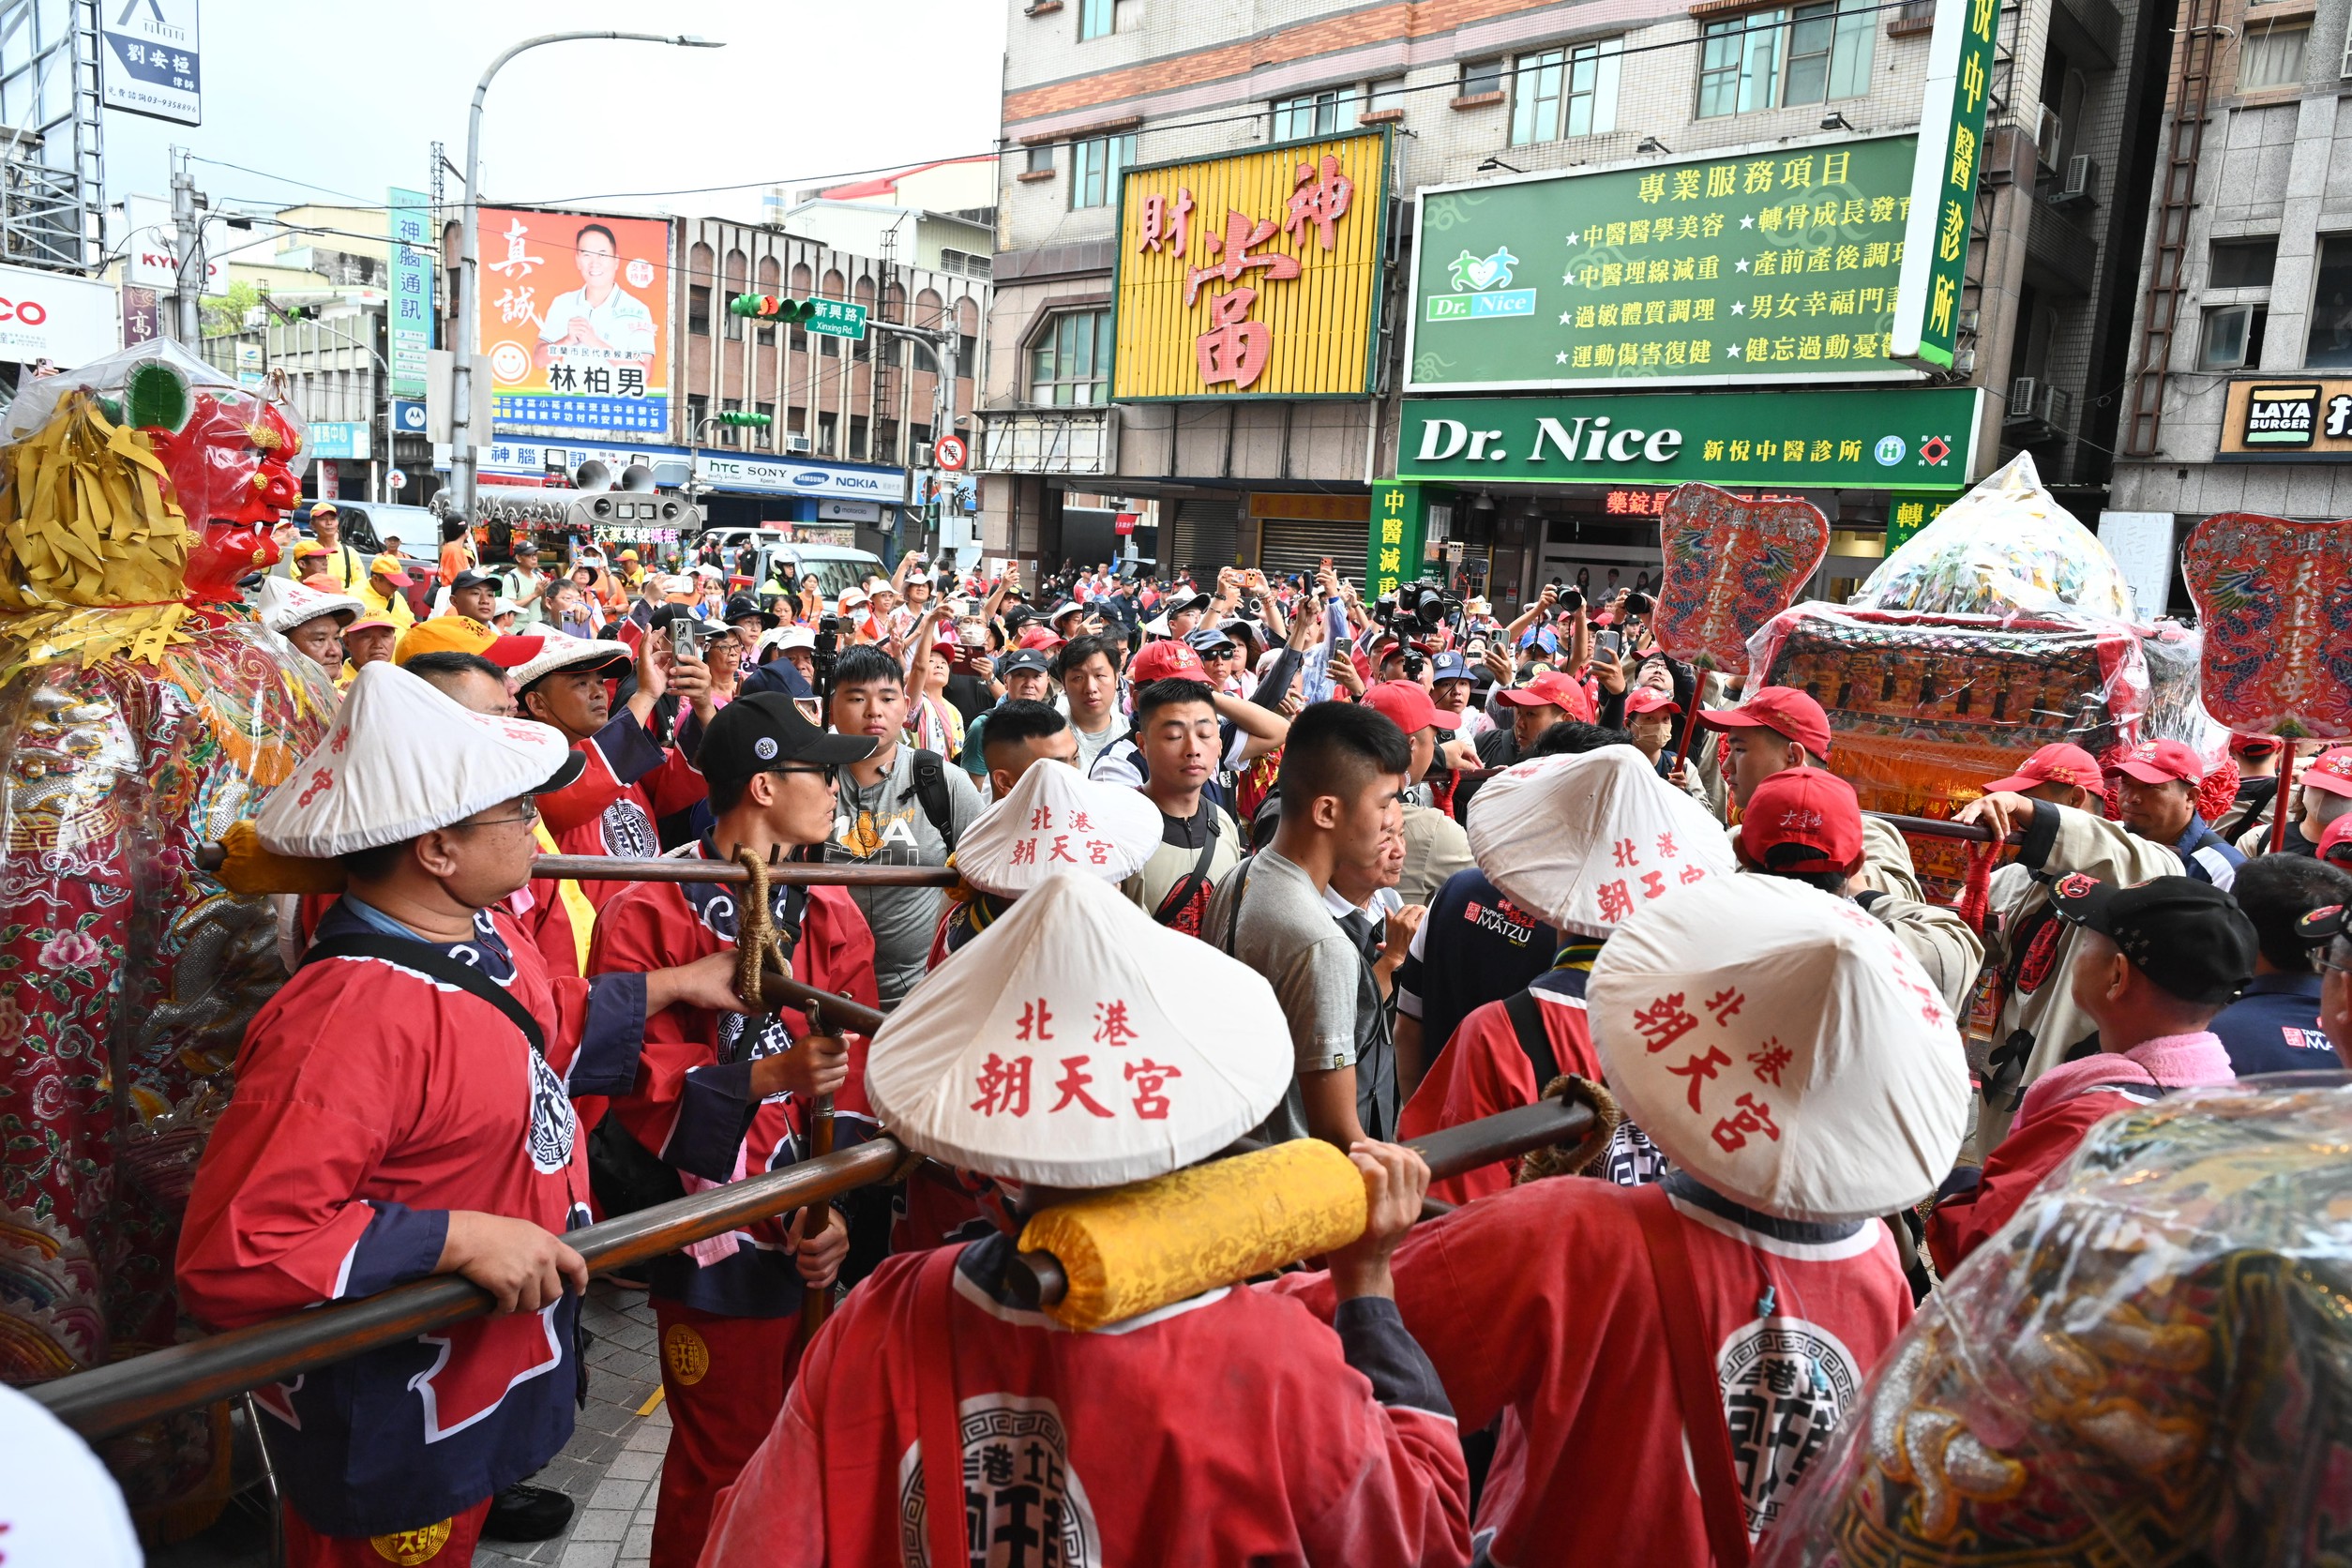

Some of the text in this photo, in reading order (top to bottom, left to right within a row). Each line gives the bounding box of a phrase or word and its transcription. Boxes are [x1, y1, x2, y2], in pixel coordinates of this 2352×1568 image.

[127, 43, 190, 74] 劉安桓
[173, 77, 194, 90] 律師
[1637, 151, 1850, 205] 專業服務項目
[1582, 211, 1725, 249] 中醫醫學美容
[489, 217, 547, 332] 真誠
[1577, 256, 1720, 289] 中醫埋線減重
[815, 301, 857, 323] 新興路
[1436, 293, 1527, 316] Dr. Nice
[1574, 298, 1716, 329] 過敏體質調理
[817, 322, 853, 335] Xinxing Rd.
[550, 346, 644, 361] 宜蘭市民代表候選人
[1571, 339, 1712, 369] 運動傷害復健
[550, 364, 644, 398] 林柏男
[2252, 402, 2311, 418] LAYA
[2249, 418, 2310, 430] BURGER
[1414, 415, 1682, 463] Dr. Nice
[1702, 438, 1863, 463] 新悅中醫診所
[490, 445, 587, 468] 神腦訊
[943, 445, 958, 461] 停
[747, 465, 787, 478] SONY
[797, 474, 826, 484] SAMSUNG
[836, 476, 879, 490] NOKIA
[841, 506, 867, 515] motorola
[873, 807, 916, 830] Taiping
[1031, 806, 1095, 833] 北港
[1009, 835, 1113, 867] 朝天宮
[1612, 831, 1679, 868] 北港
[1482, 906, 1504, 920] TAIPING
[1476, 913, 1531, 942] MATZU
[1016, 997, 1138, 1047] 北港
[1705, 986, 1793, 1088] 北港
[1634, 991, 1780, 1153] 朝天宮
[970, 1053, 1182, 1121] 朝天宮
